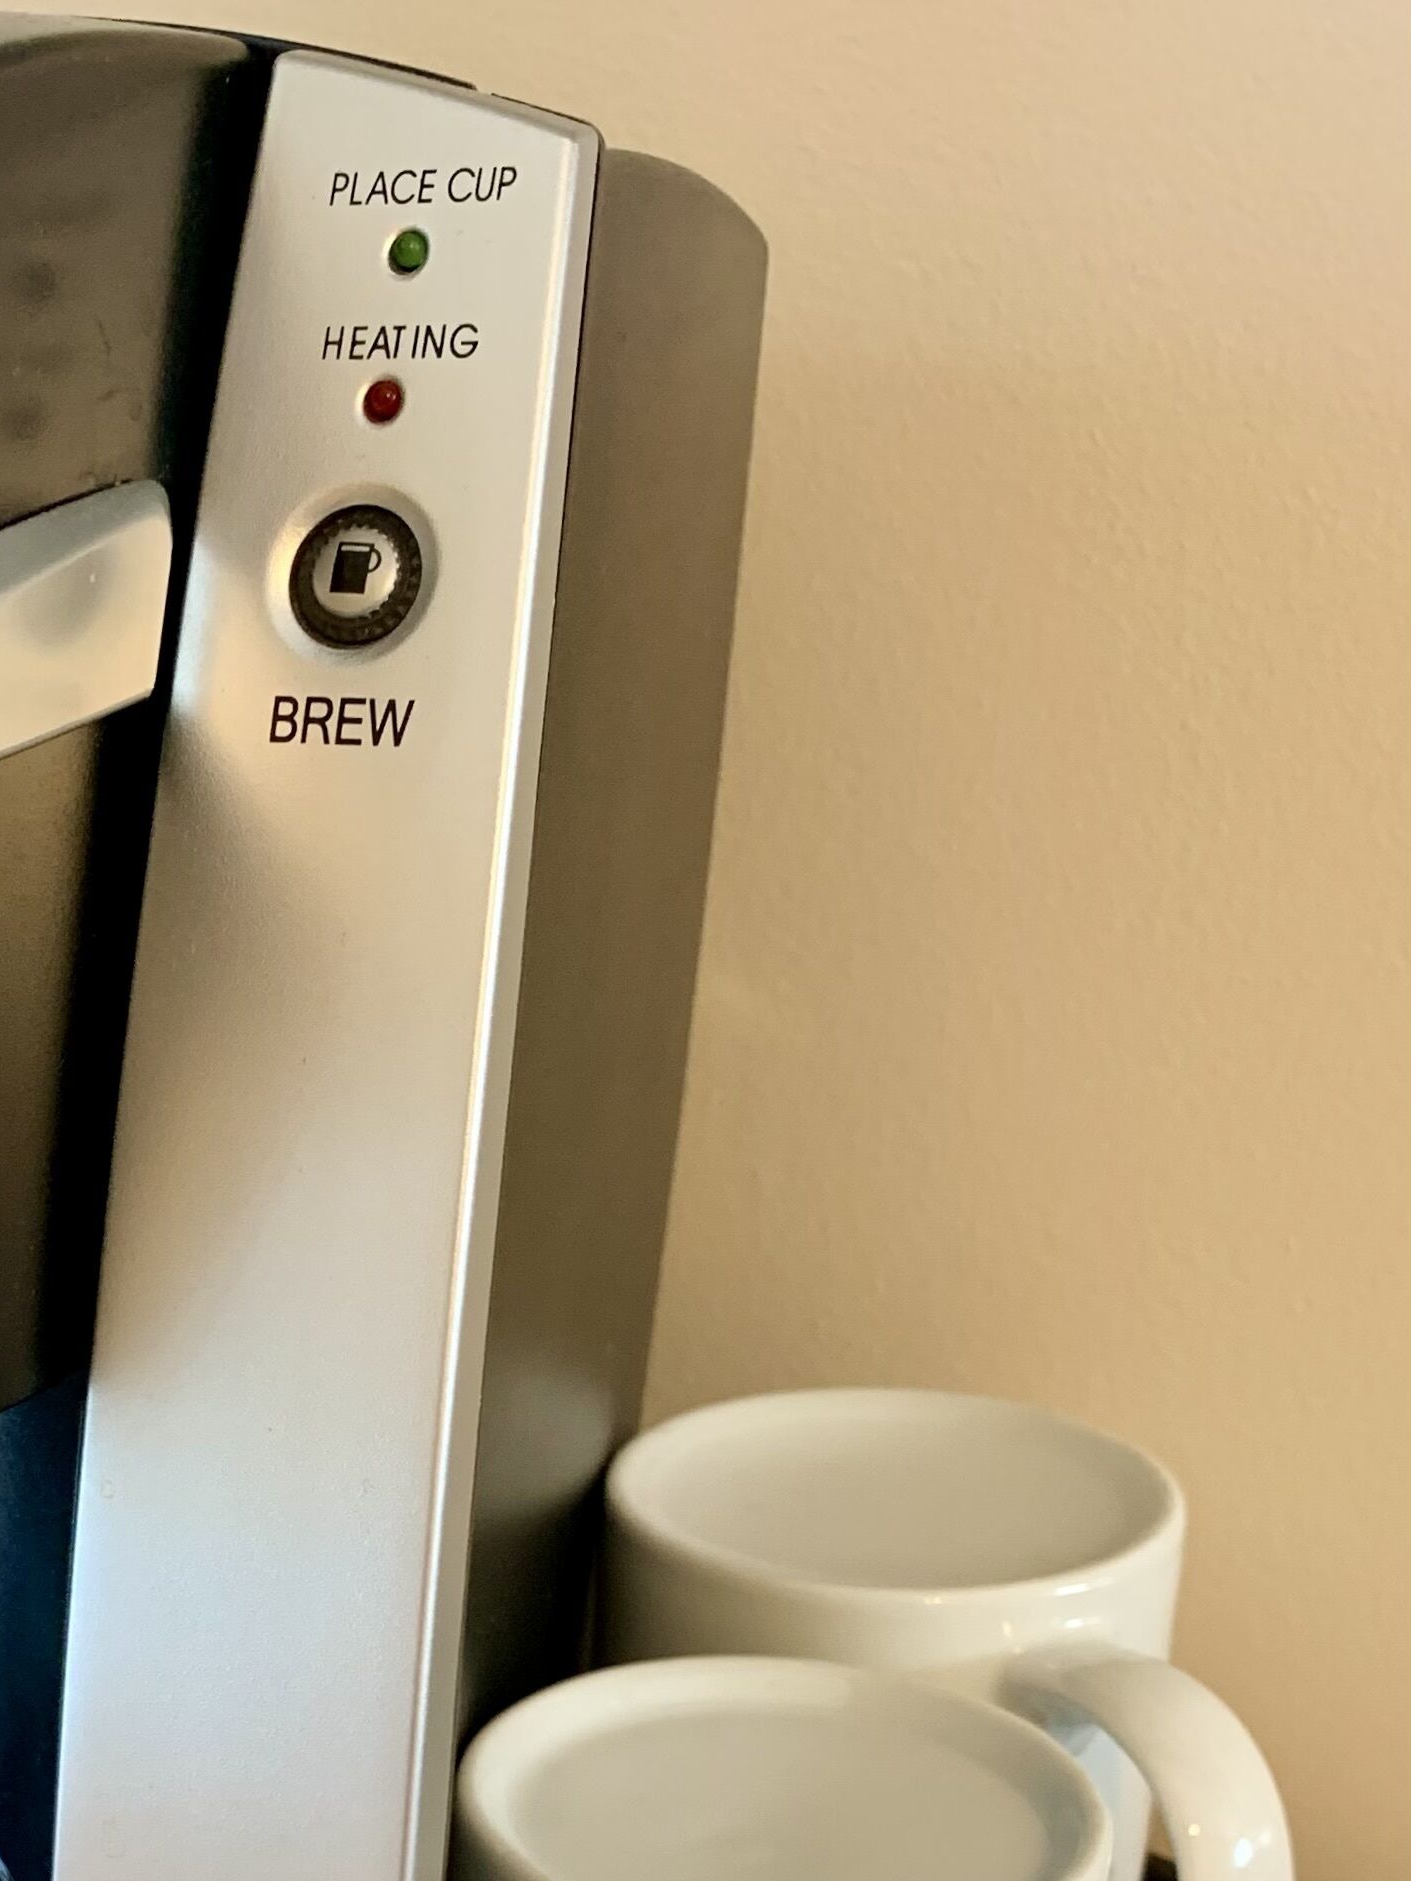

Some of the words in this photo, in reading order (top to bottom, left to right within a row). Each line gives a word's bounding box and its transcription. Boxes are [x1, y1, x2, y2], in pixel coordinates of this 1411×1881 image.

[329, 169, 438, 207] PLACE
[447, 166, 518, 202] CUP
[322, 324, 479, 361] HEATING
[269, 695, 415, 747] BREW
